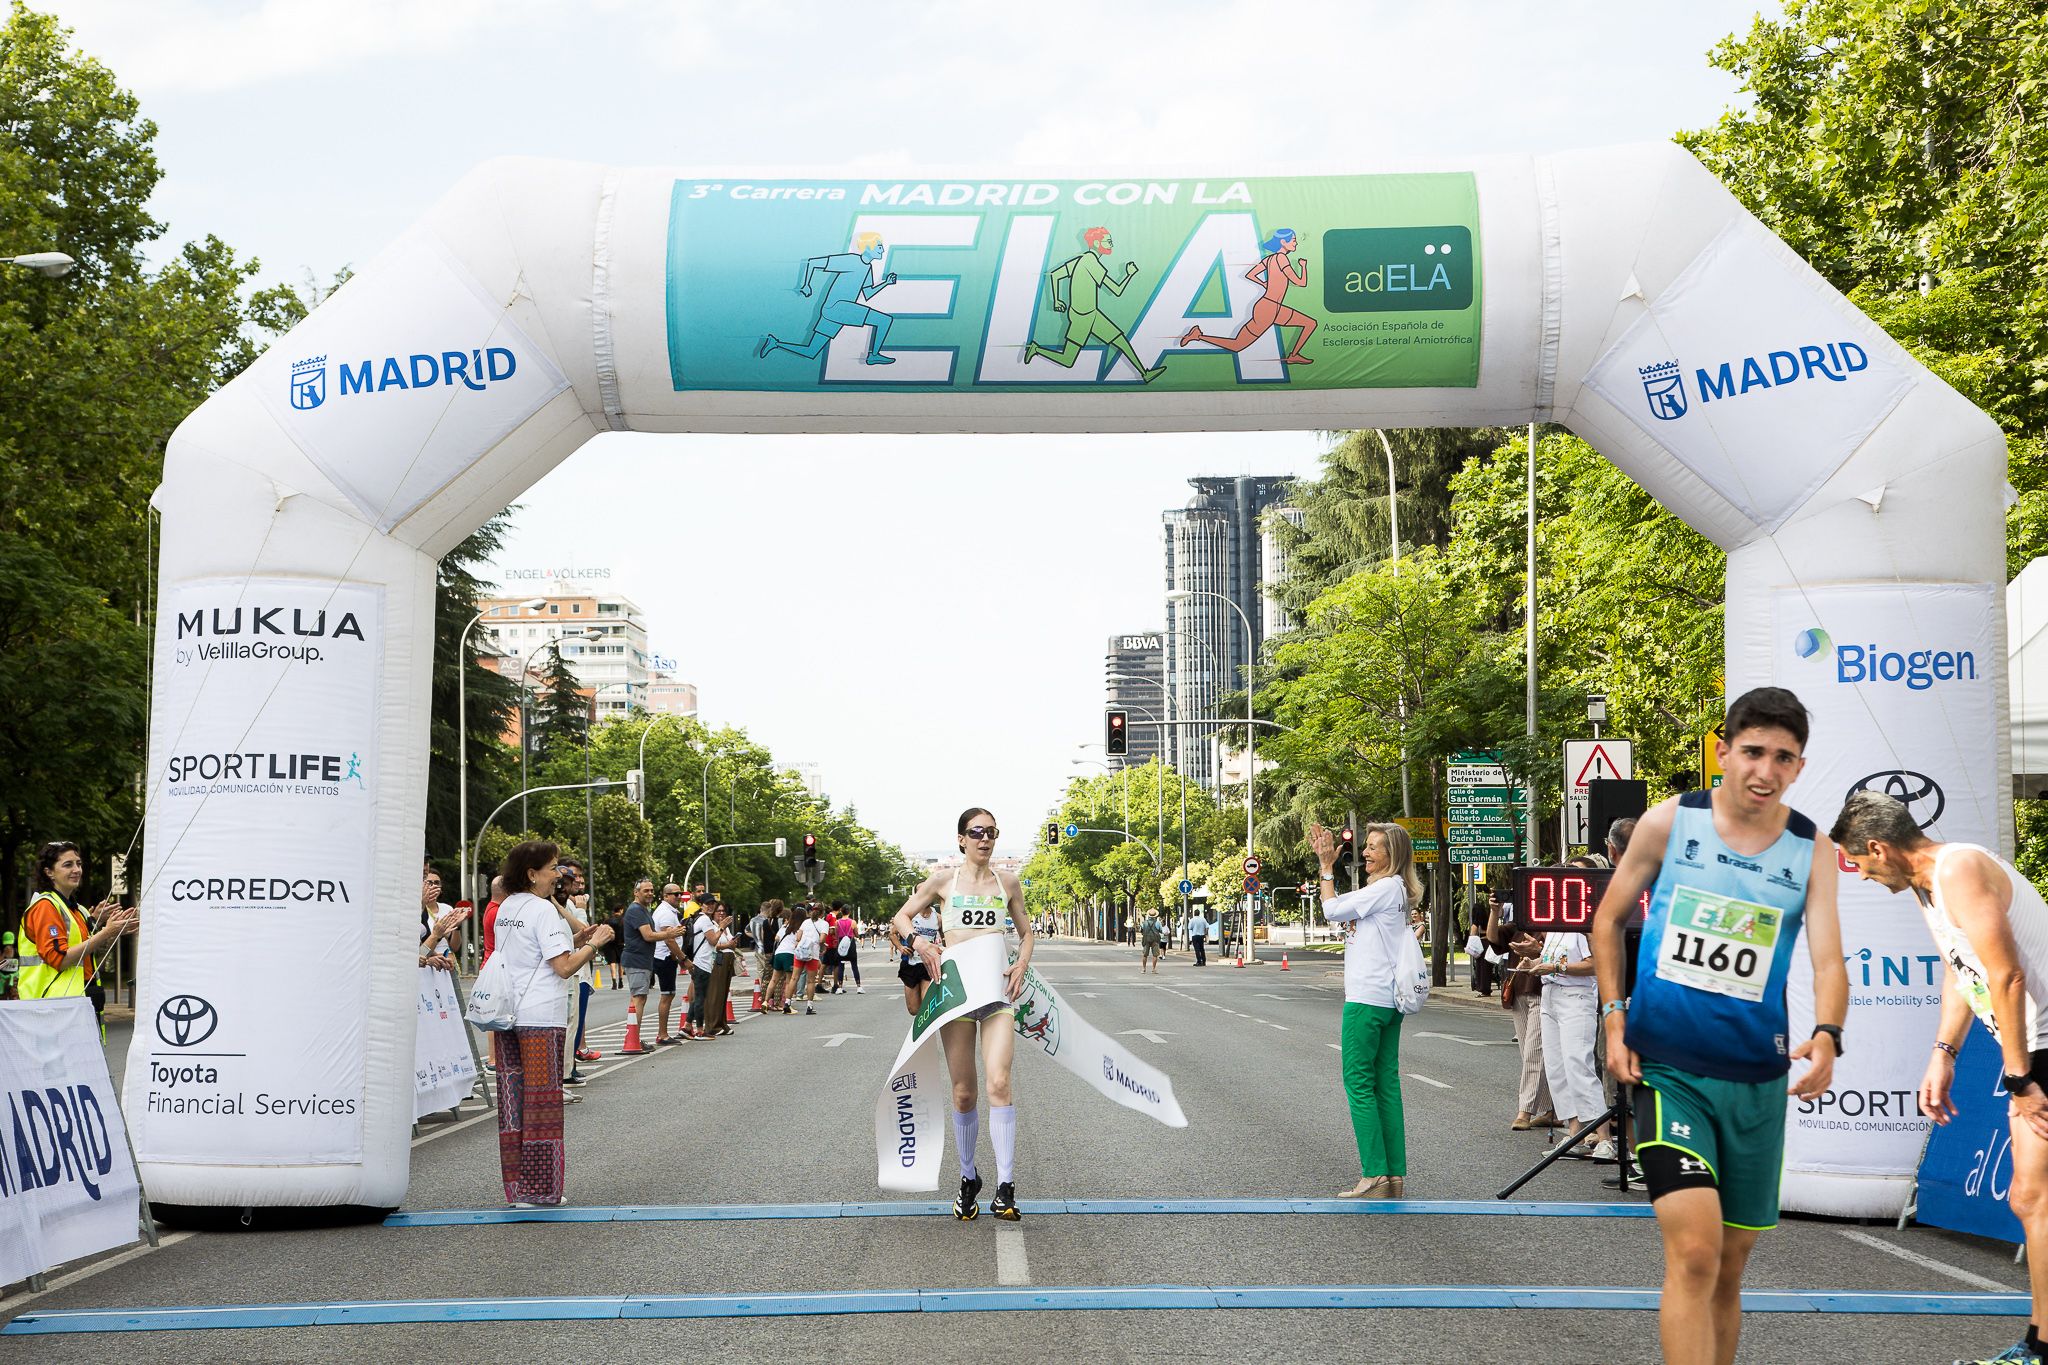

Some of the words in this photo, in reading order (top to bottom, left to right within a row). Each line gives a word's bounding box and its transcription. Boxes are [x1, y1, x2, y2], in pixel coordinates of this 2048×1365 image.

[730, 185, 846, 200] Carrera
[859, 183, 1060, 205] MADRID
[1073, 183, 1180, 205] CON
[1191, 181, 1253, 204] LA
[1344, 263, 1451, 293] adELA
[818, 211, 1292, 385] ELA
[1323, 322, 1379, 332] Asociación
[1382, 320, 1428, 332] Española
[1431, 321, 1444, 330] de
[1323, 337, 1373, 347] Esclerosis
[1376, 336, 1411, 346] Lateral
[1413, 335, 1473, 345] Amiotrófica
[340, 347, 517, 396] MADRID
[1696, 342, 1869, 403] MADRID
[178, 607, 365, 641] MUKUA
[177, 648, 193, 666] by
[198, 641, 324, 664] VelillaGroup.
[1123, 636, 1160, 650] BBVA
[501, 660, 519, 670] AC
[169, 753, 341, 782] SPORTLIFE
[210, 783, 283, 794] COMUNICACIÓN
[287, 785, 293, 794] Y
[295, 785, 339, 796] EVENTOS
[1450, 795, 1466, 803] San
[1468, 795, 1502, 803] Germán
[1451, 814, 1480, 822] Alberto
[1461, 854, 1507, 862] Dominicana
[961, 910, 996, 926] 828
[1672, 932, 1758, 979] 1160
[917, 985, 954, 1028] adELA
[1848, 996, 1873, 1006] ible
[1876, 996, 1923, 1008] Mobility
[150, 1061, 218, 1088] Toyota
[1116, 1068, 1160, 1103] MADRID
[148, 1091, 245, 1114] Financial
[255, 1093, 355, 1115] Services
[896, 1094, 916, 1168] MADRID
[1799, 1119, 1852, 1132] MOVILIDAD,
[1854, 1120, 1933, 1132] COMUNICACIÓN
[1965, 1128, 1999, 1197] al
